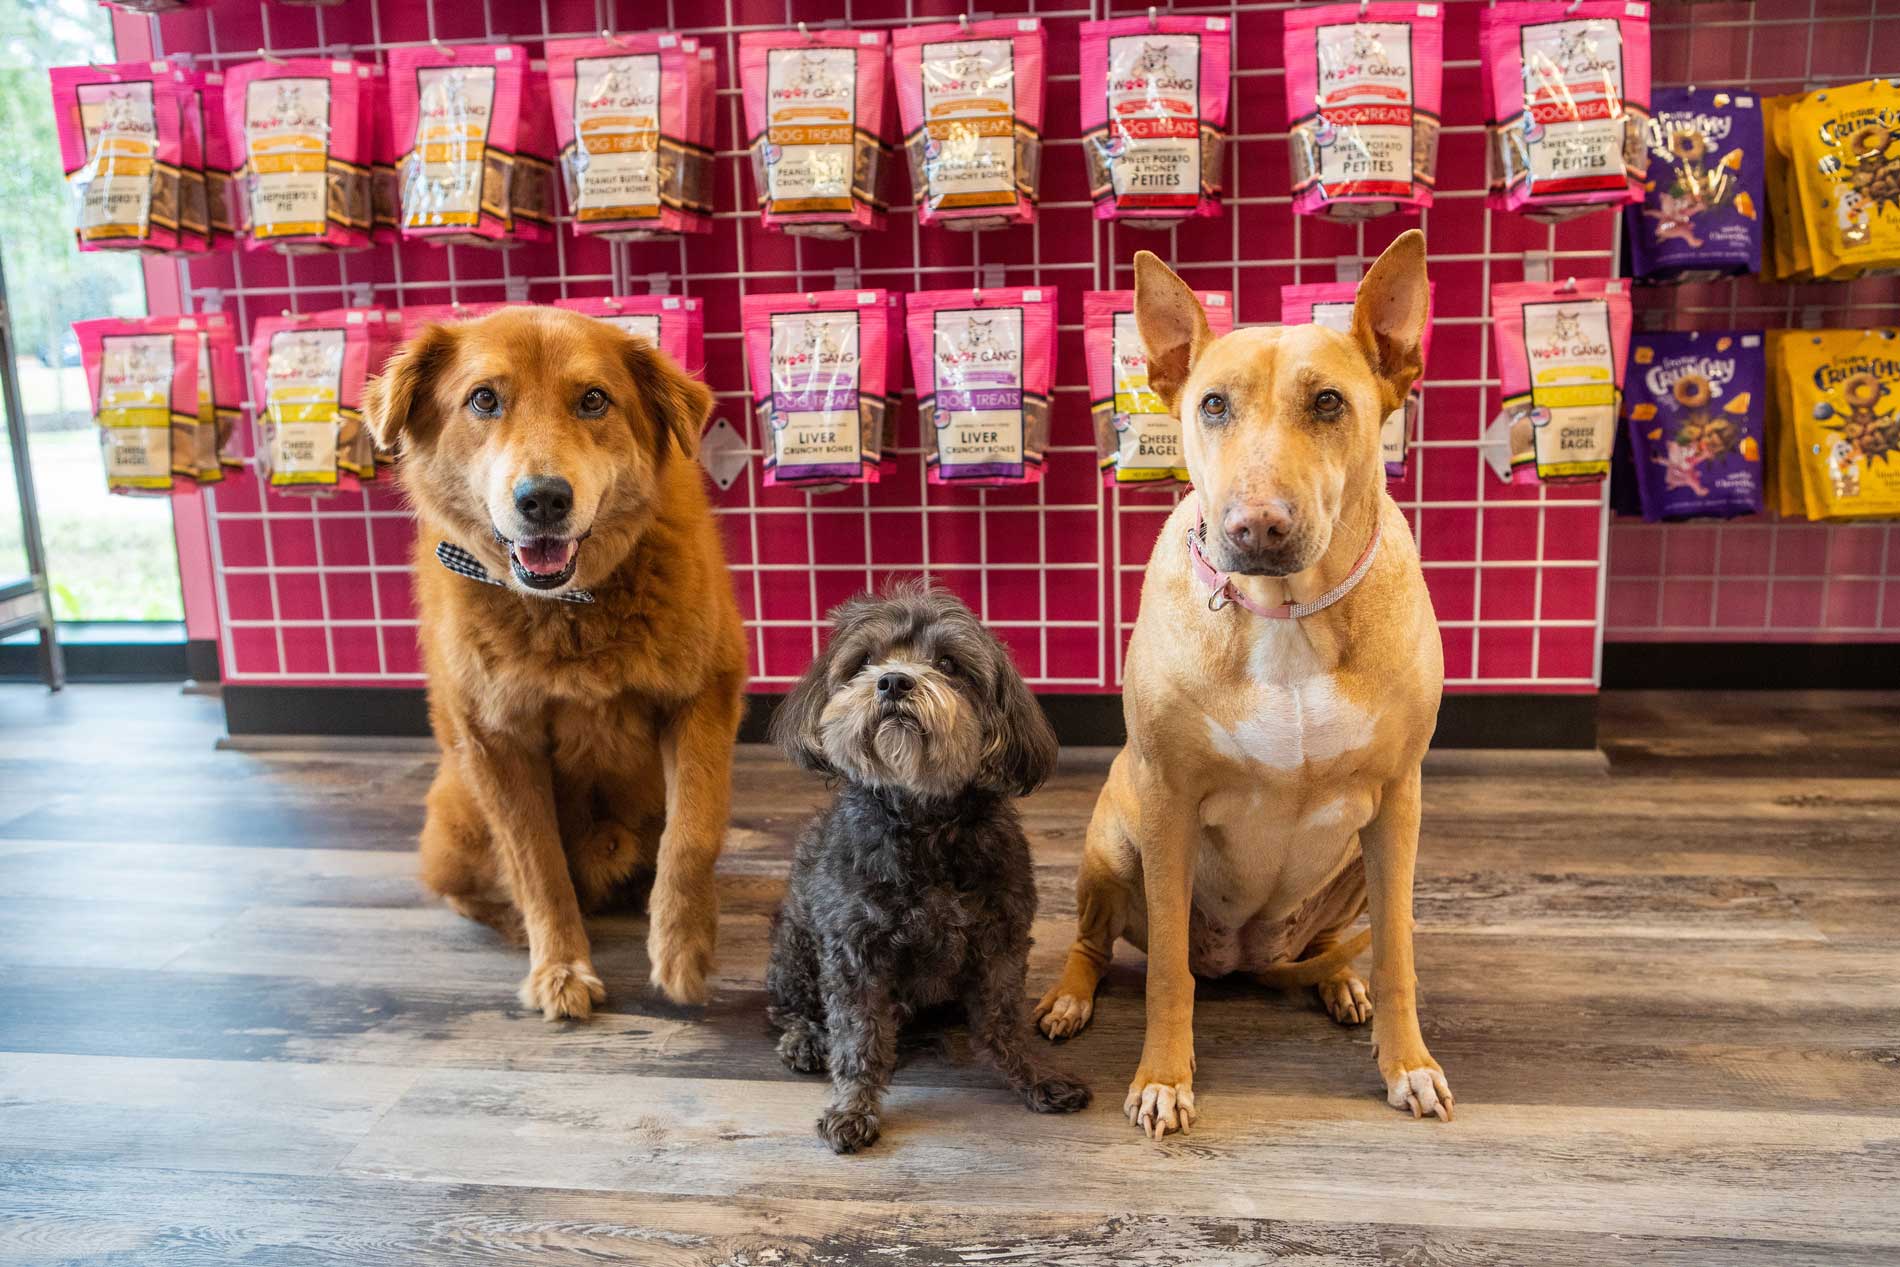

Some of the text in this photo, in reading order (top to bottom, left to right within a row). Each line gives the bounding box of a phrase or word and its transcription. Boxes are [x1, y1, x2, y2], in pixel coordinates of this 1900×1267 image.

[1368, 63, 1407, 77] GANG
[1575, 60, 1616, 74] GANG
[1155, 78, 1193, 91] GANG
[1323, 106, 1410, 123] DOG TREATS
[769, 128, 851, 142] DOG TREATS
[1111, 120, 1198, 137] DOG TREATS
[1334, 142, 1362, 153] SWEE
[1153, 154, 1191, 163] POTATO
[1356, 150, 1390, 159] HNEY
[1144, 164, 1177, 172] HONEY
[1342, 159, 1394, 173] PETITES
[1131, 174, 1181, 186] PETITES
[980, 350, 1017, 362] GANG
[1531, 345, 1607, 359] WOOF GANG
[776, 352, 854, 366] WOOF GANG
[1121, 354, 1147, 367] WOO
[814, 393, 857, 407] TRATS
[939, 393, 1019, 408] DOG TREATS
[799, 432, 836, 445] LIVER
[961, 431, 998, 444] LIVER
[1560, 427, 1595, 438] CHEESE
[1138, 434, 1178, 445] CHEESE
[1560, 438, 1595, 450] BAGEL
[783, 445, 854, 456] CRUNCHY BONES
[945, 445, 1016, 455] CRUNCHY BONES
[1138, 445, 1178, 456] BAGEL
